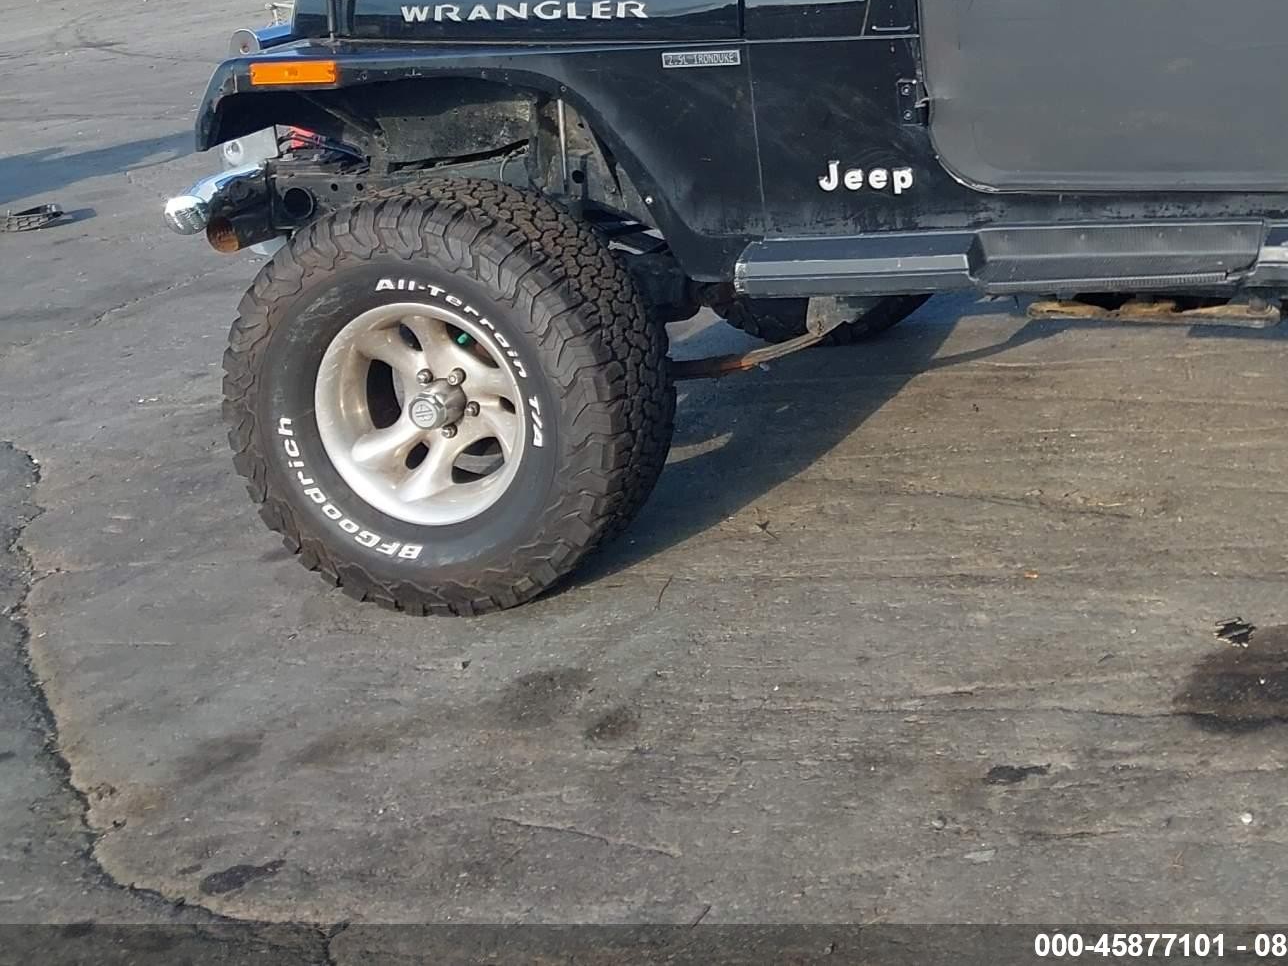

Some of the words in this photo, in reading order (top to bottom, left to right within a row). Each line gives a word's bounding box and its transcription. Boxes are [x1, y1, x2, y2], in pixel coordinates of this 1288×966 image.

[401, 0, 648, 22] WRANGLER
[818, 160, 913, 194] Jeep
[375, 279, 527, 378] All-Terrain
[529, 396, 543, 447] T/A
[278, 417, 423, 559] BFGoodrich
